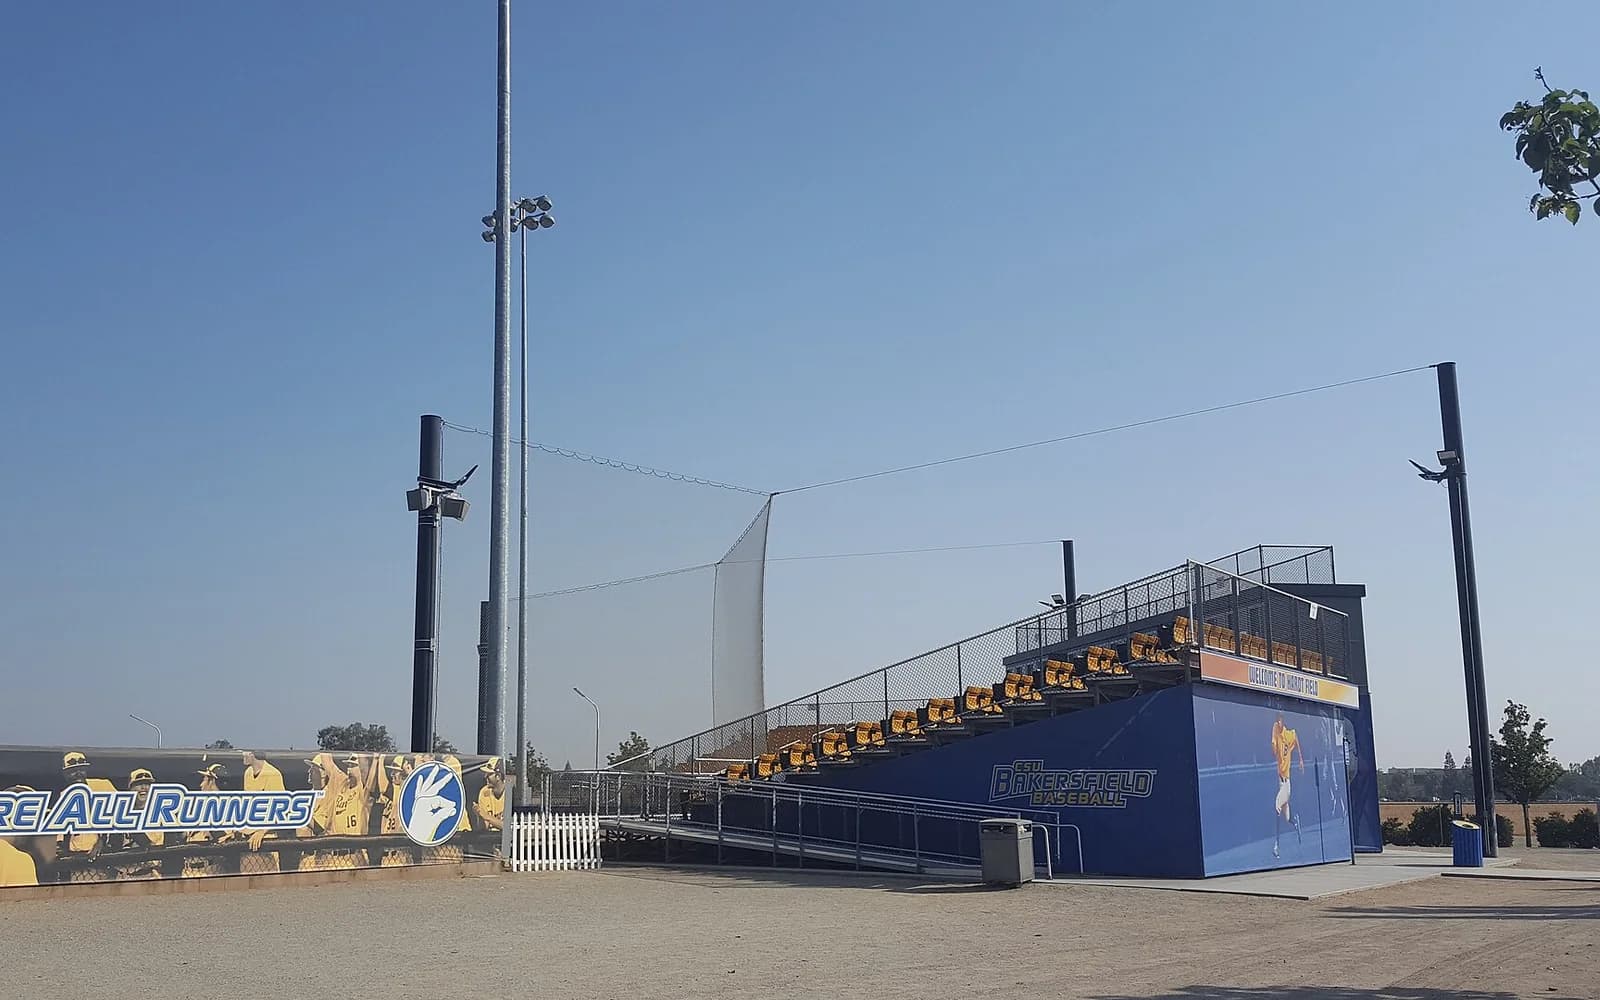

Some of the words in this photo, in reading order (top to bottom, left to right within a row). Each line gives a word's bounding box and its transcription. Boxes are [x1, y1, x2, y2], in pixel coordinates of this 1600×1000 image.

[1249, 666, 1279, 688] WELCOME
[1279, 671, 1286, 689] TO
[1305, 678, 1318, 697] FIELD
[1014, 762, 1042, 772] CSU
[992, 766, 1153, 797] BAKERSFIELD
[53, 792, 136, 827] ALL
[148, 791, 311, 825] RUNNERS
[1031, 791, 1124, 806] BASEBALL
[346, 814, 358, 829] 16
